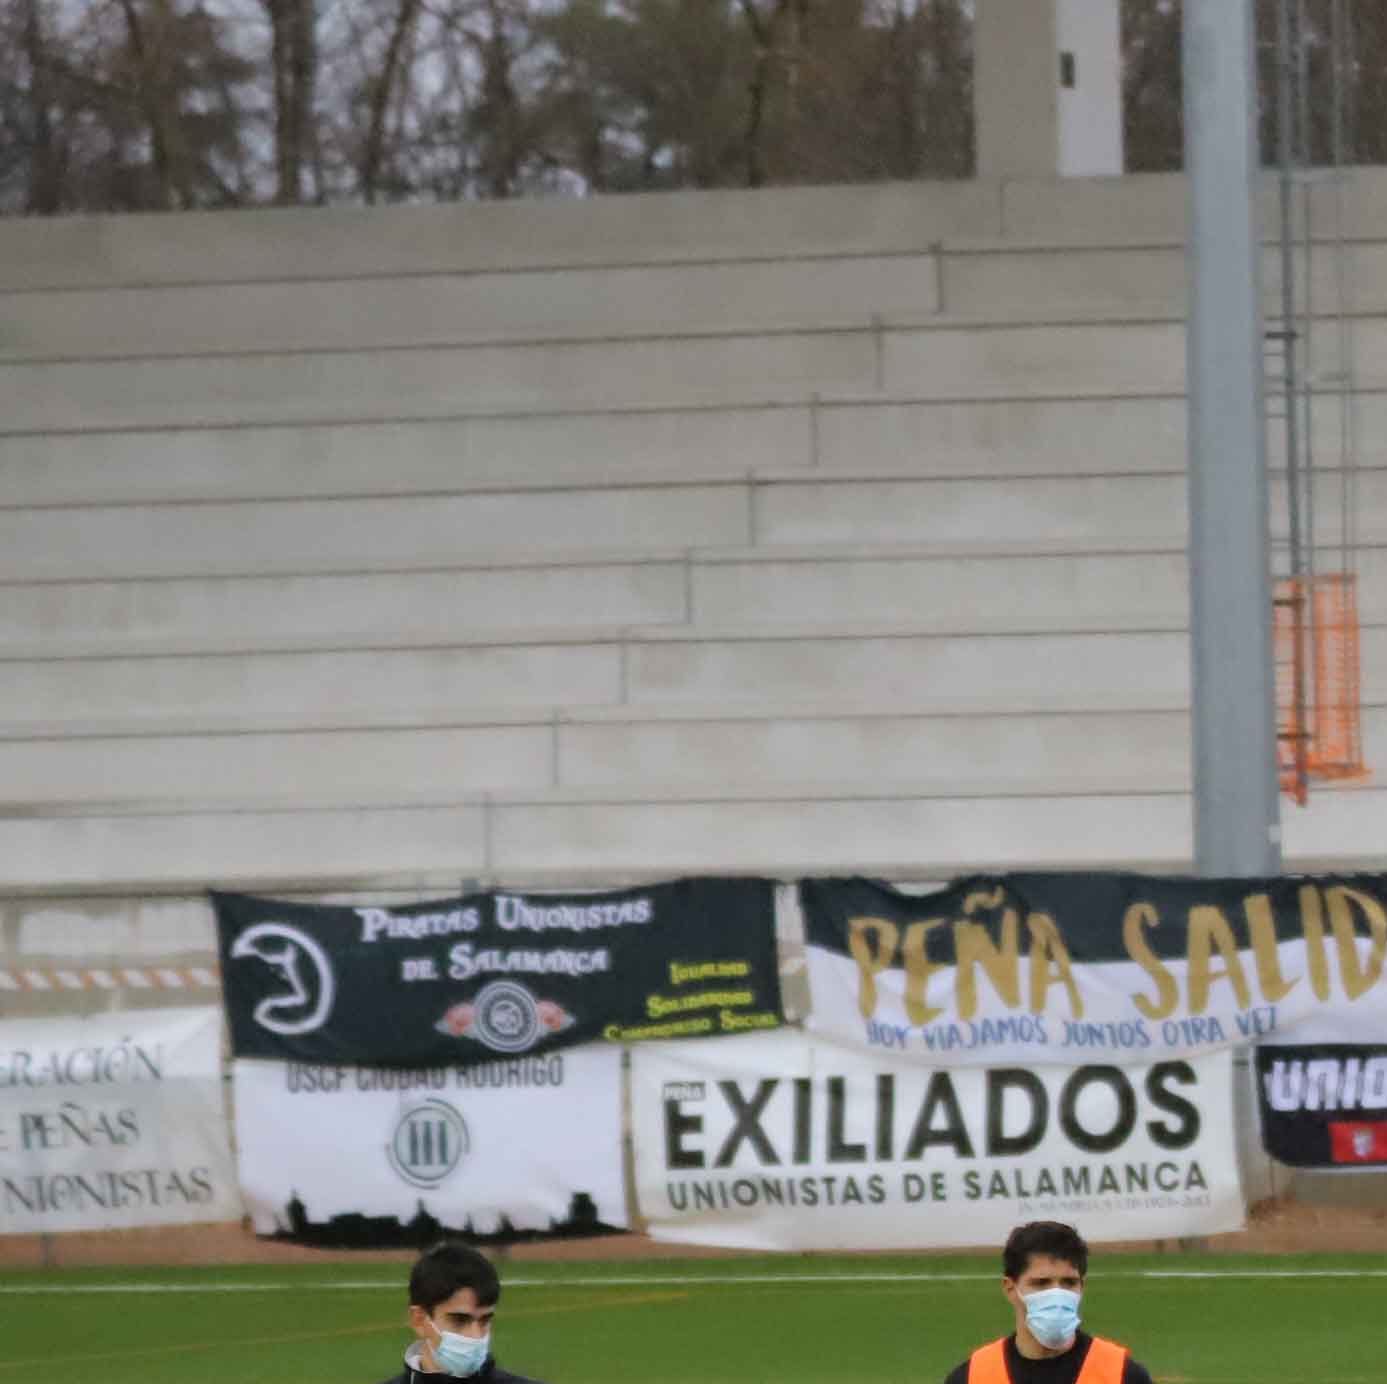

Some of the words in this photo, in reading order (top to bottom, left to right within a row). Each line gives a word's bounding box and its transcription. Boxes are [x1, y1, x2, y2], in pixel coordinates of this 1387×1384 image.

[848, 885, 1084, 1027] PEÑA
[664, 1059, 1200, 1171] EXILIADOS
[666, 1171, 888, 1211] UNIONISTAS
[903, 1172, 947, 1203] DE
[962, 1160, 1209, 1201] SALAMANCA
